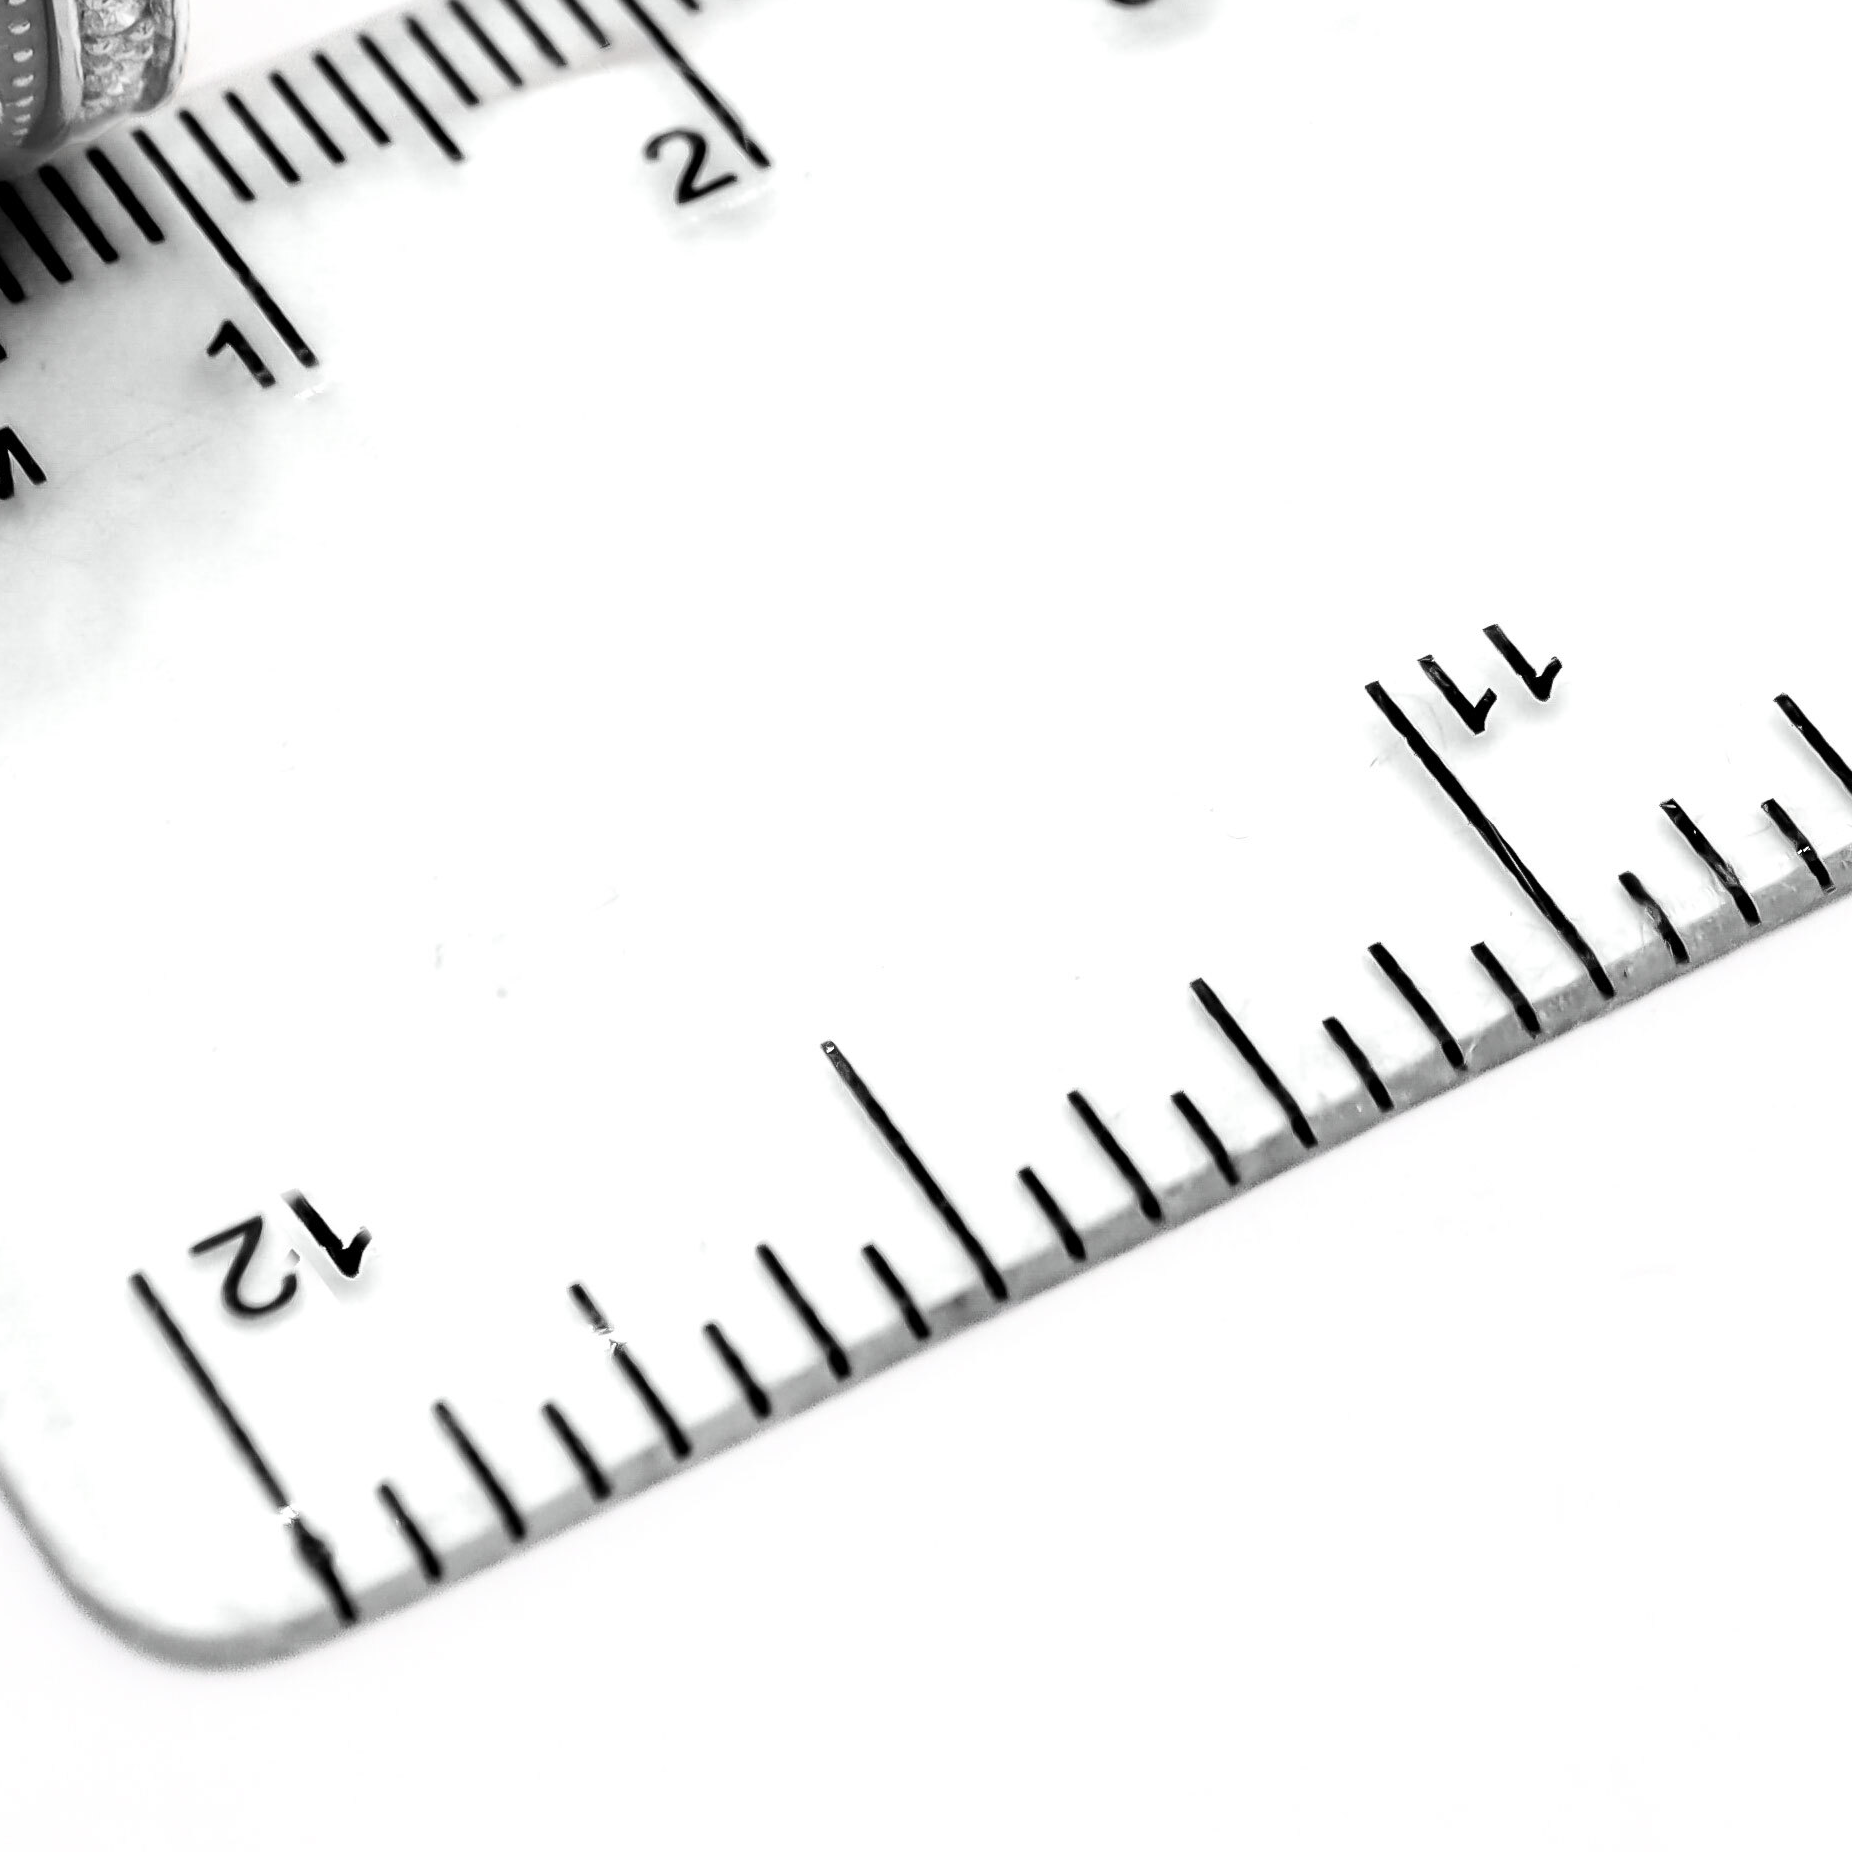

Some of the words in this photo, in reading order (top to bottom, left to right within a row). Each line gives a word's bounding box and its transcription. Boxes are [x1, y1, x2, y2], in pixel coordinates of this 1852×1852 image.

[644, 129, 738, 204] 2
[206, 319, 276, 389] 1
[1420, 625, 1568, 735] 11
[190, 1184, 373, 1319] 12
